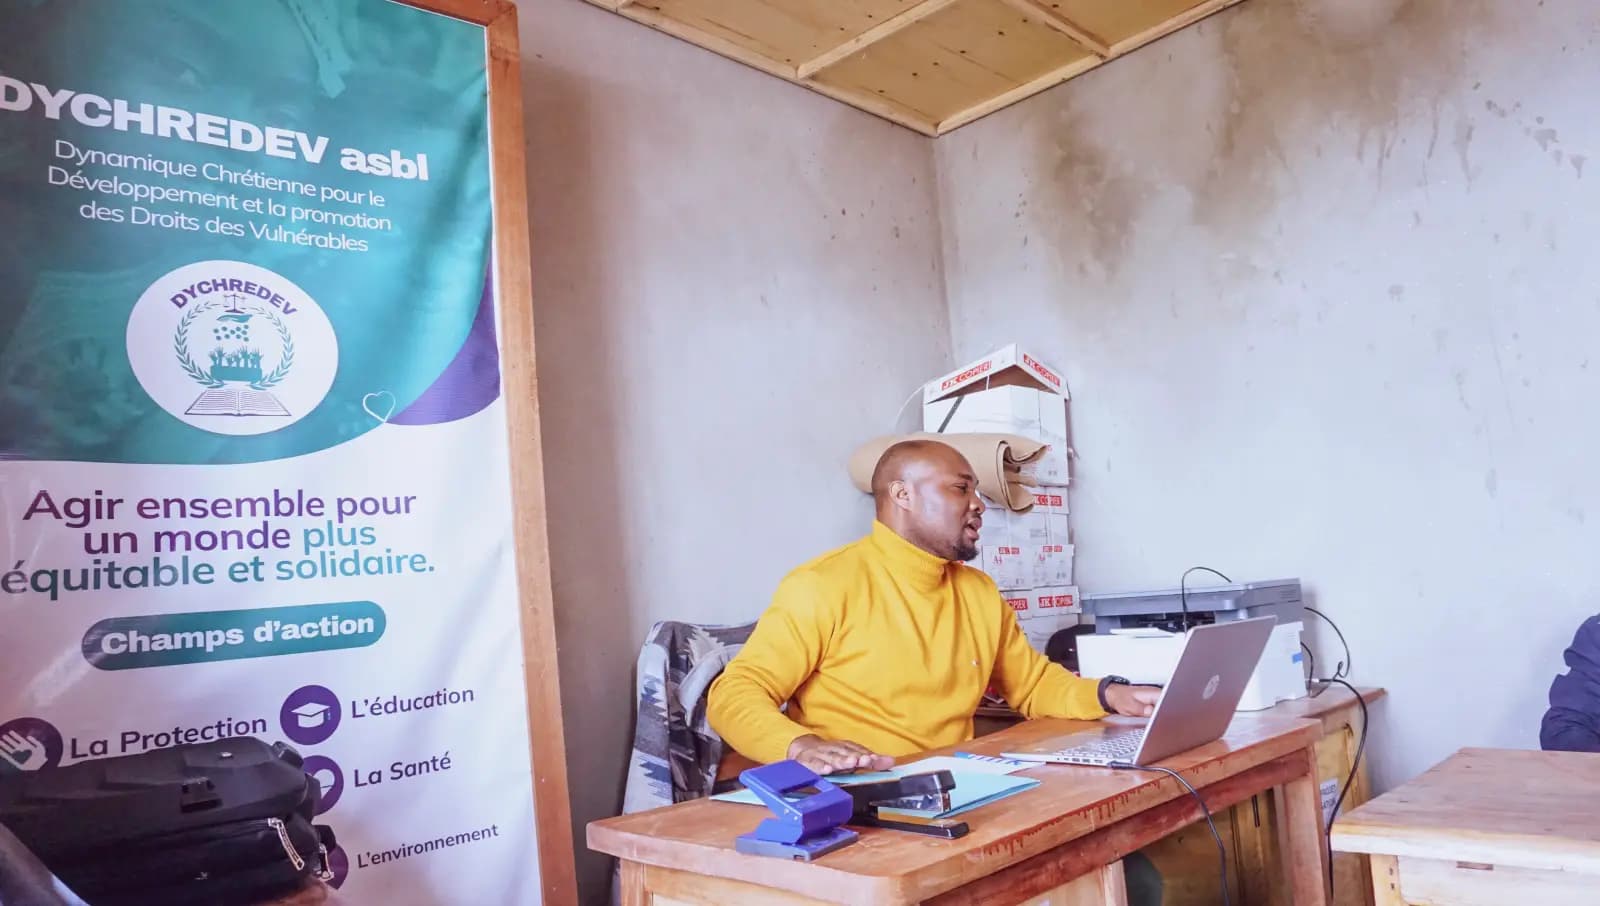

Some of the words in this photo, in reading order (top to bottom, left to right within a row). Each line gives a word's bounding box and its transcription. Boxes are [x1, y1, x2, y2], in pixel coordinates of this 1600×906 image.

[0, 75, 329, 164] DYCHREDEV
[340, 147, 429, 181] asbl
[55, 139, 197, 179] Dynamique
[202, 162, 317, 197] Chrétienne
[320, 185, 366, 205] pour
[369, 190, 386, 207] le
[48, 165, 239, 211] Développement
[242, 198, 264, 215] et
[268, 199, 287, 217] la
[291, 205, 392, 231] promotion
[79, 200, 125, 223] des
[130, 205, 200, 231] Droits
[204, 215, 245, 238] des
[248, 221, 369, 252] Vulnérables
[169, 278, 297, 317] DYCHREDEV
[23, 489, 125, 528] Agir
[136, 488, 326, 520] ensemble
[336, 494, 417, 524] pour
[84, 528, 139, 555] un
[153, 521, 291, 553] monde
[303, 520, 377, 556] plus
[1, 555, 215, 600] équitable
[228, 556, 265, 583] et
[275, 548, 436, 582] solidaire.
[101, 625, 245, 655] Champs
[71, 737, 108, 759] La
[120, 717, 267, 753] Protection
[354, 768, 383, 788] La
[389, 750, 452, 781] Santé
